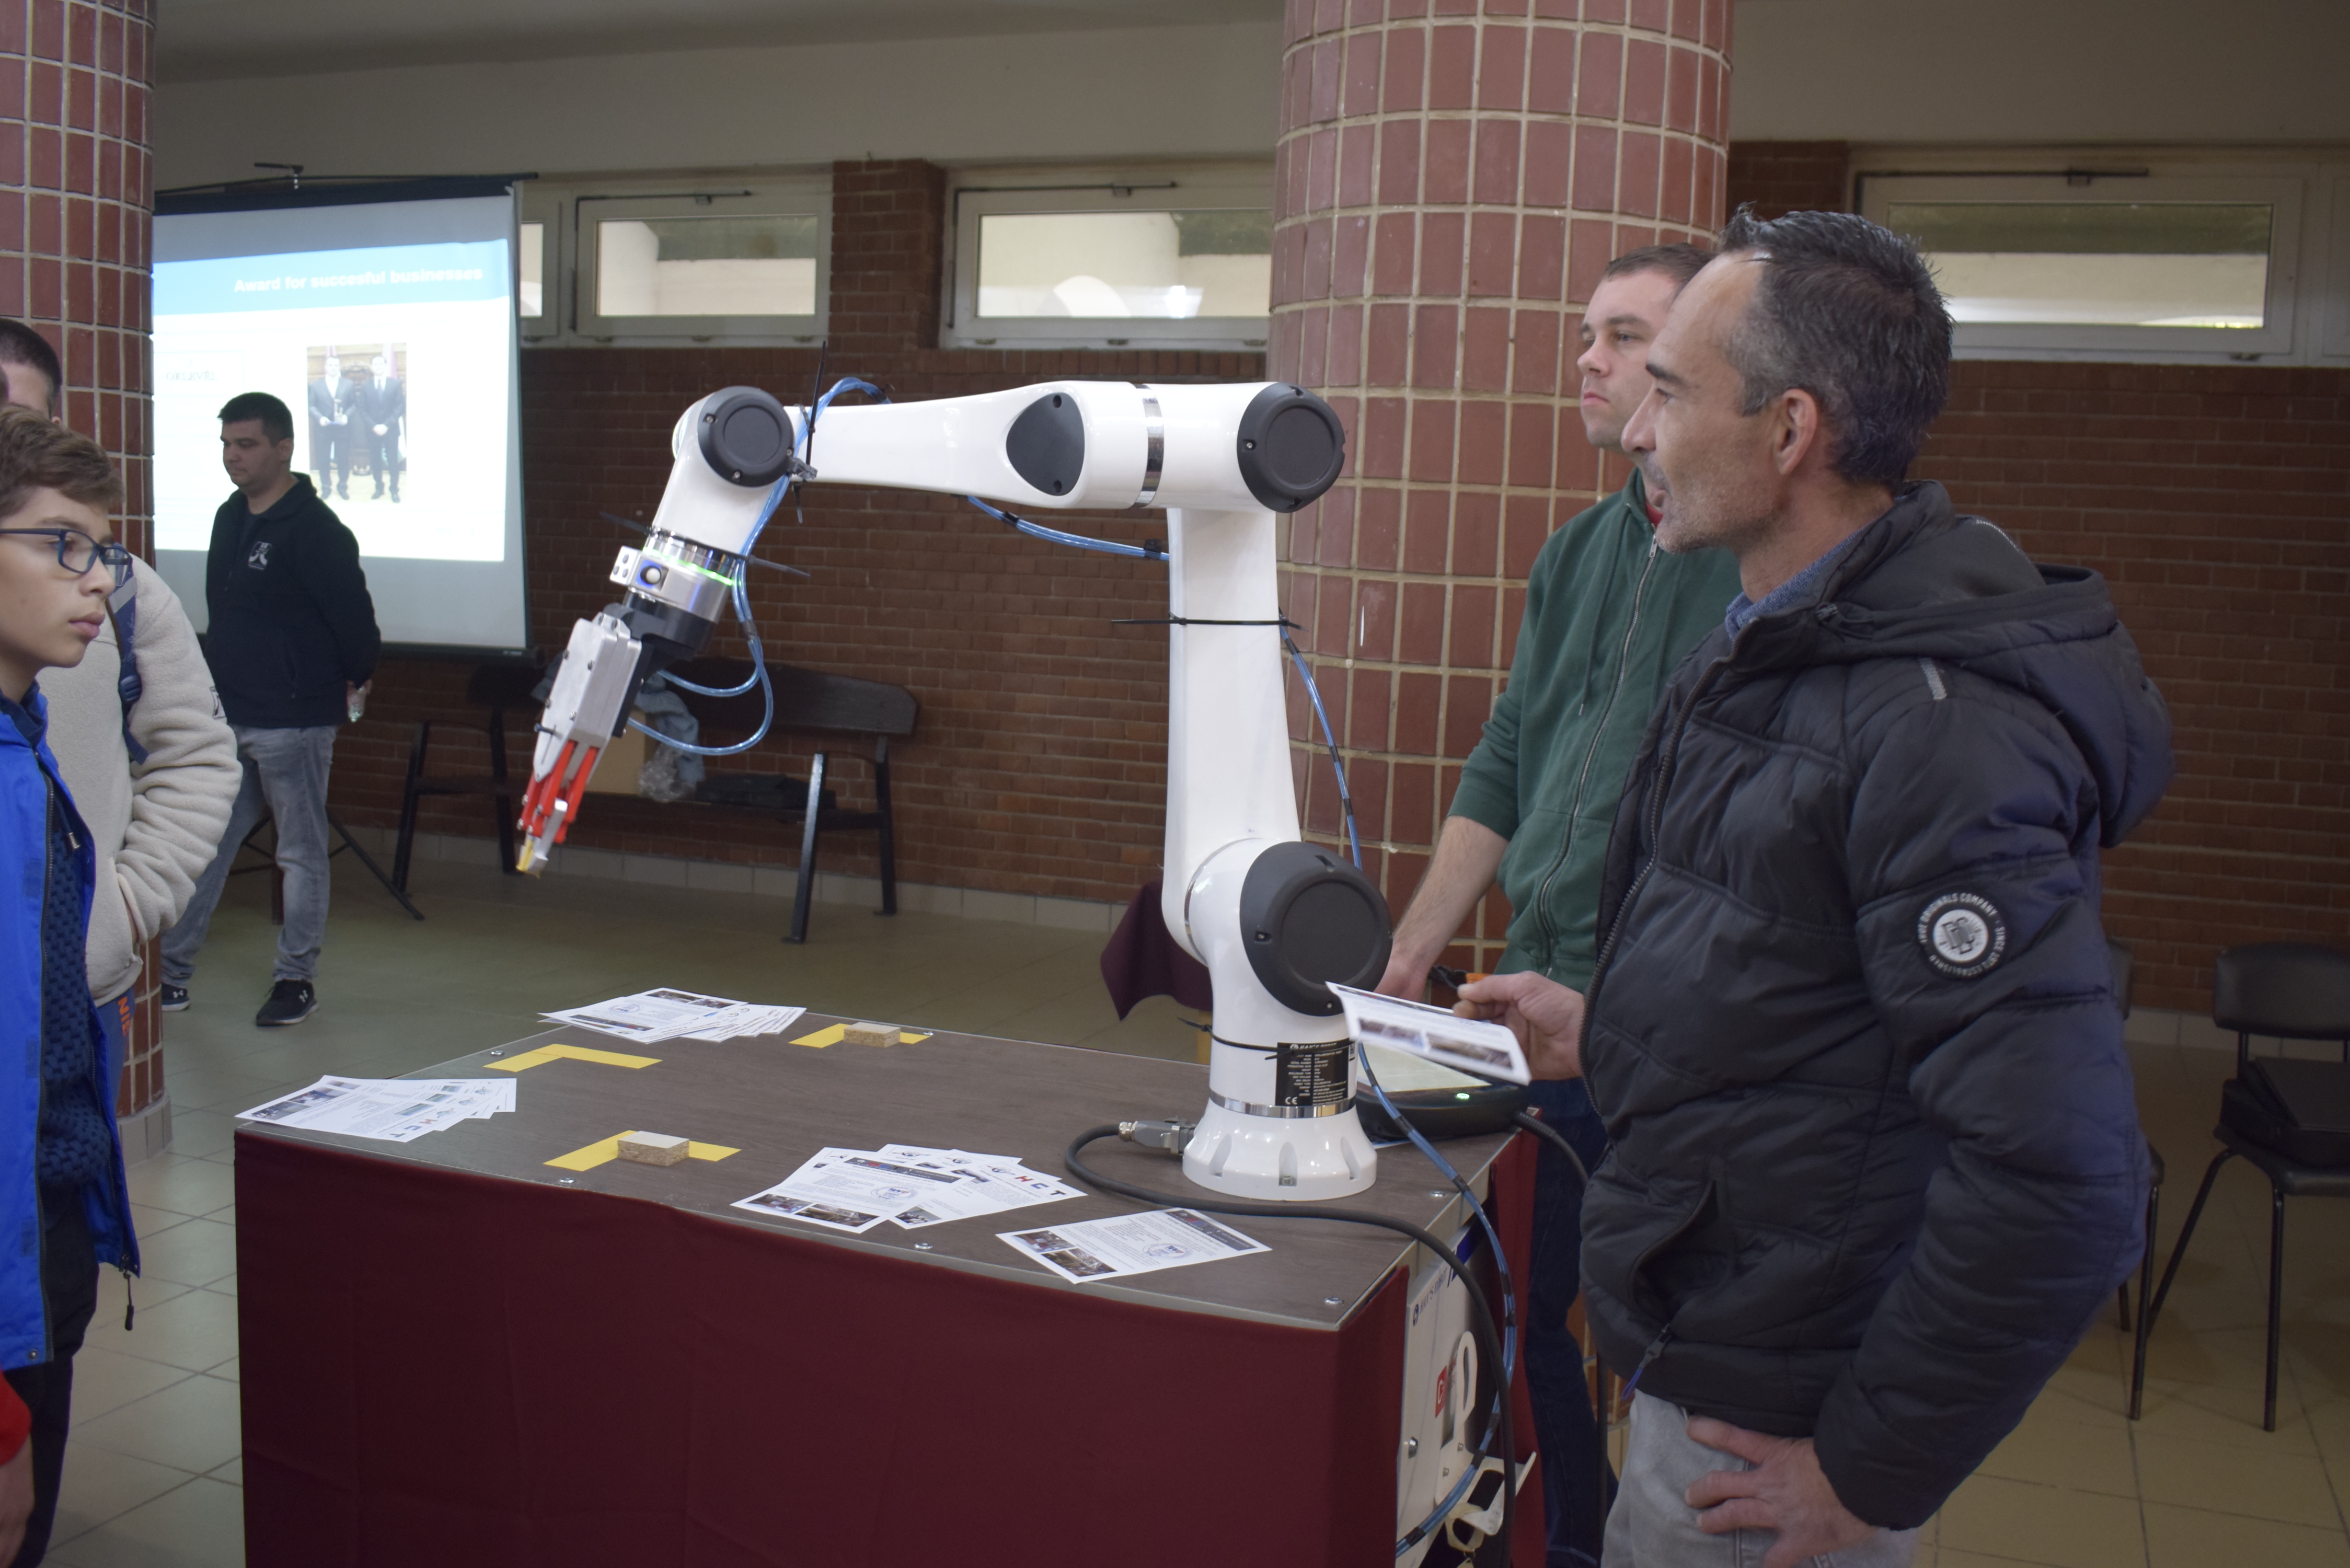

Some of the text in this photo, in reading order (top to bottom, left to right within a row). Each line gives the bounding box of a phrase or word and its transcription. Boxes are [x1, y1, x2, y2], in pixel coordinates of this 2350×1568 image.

[234, 268, 483, 292] Award for succesful businesses
[1960, 893, 1998, 916] COMPANY
[1993, 926, 2006, 951] SINCE
[1285, 1096, 1298, 1105] CE
